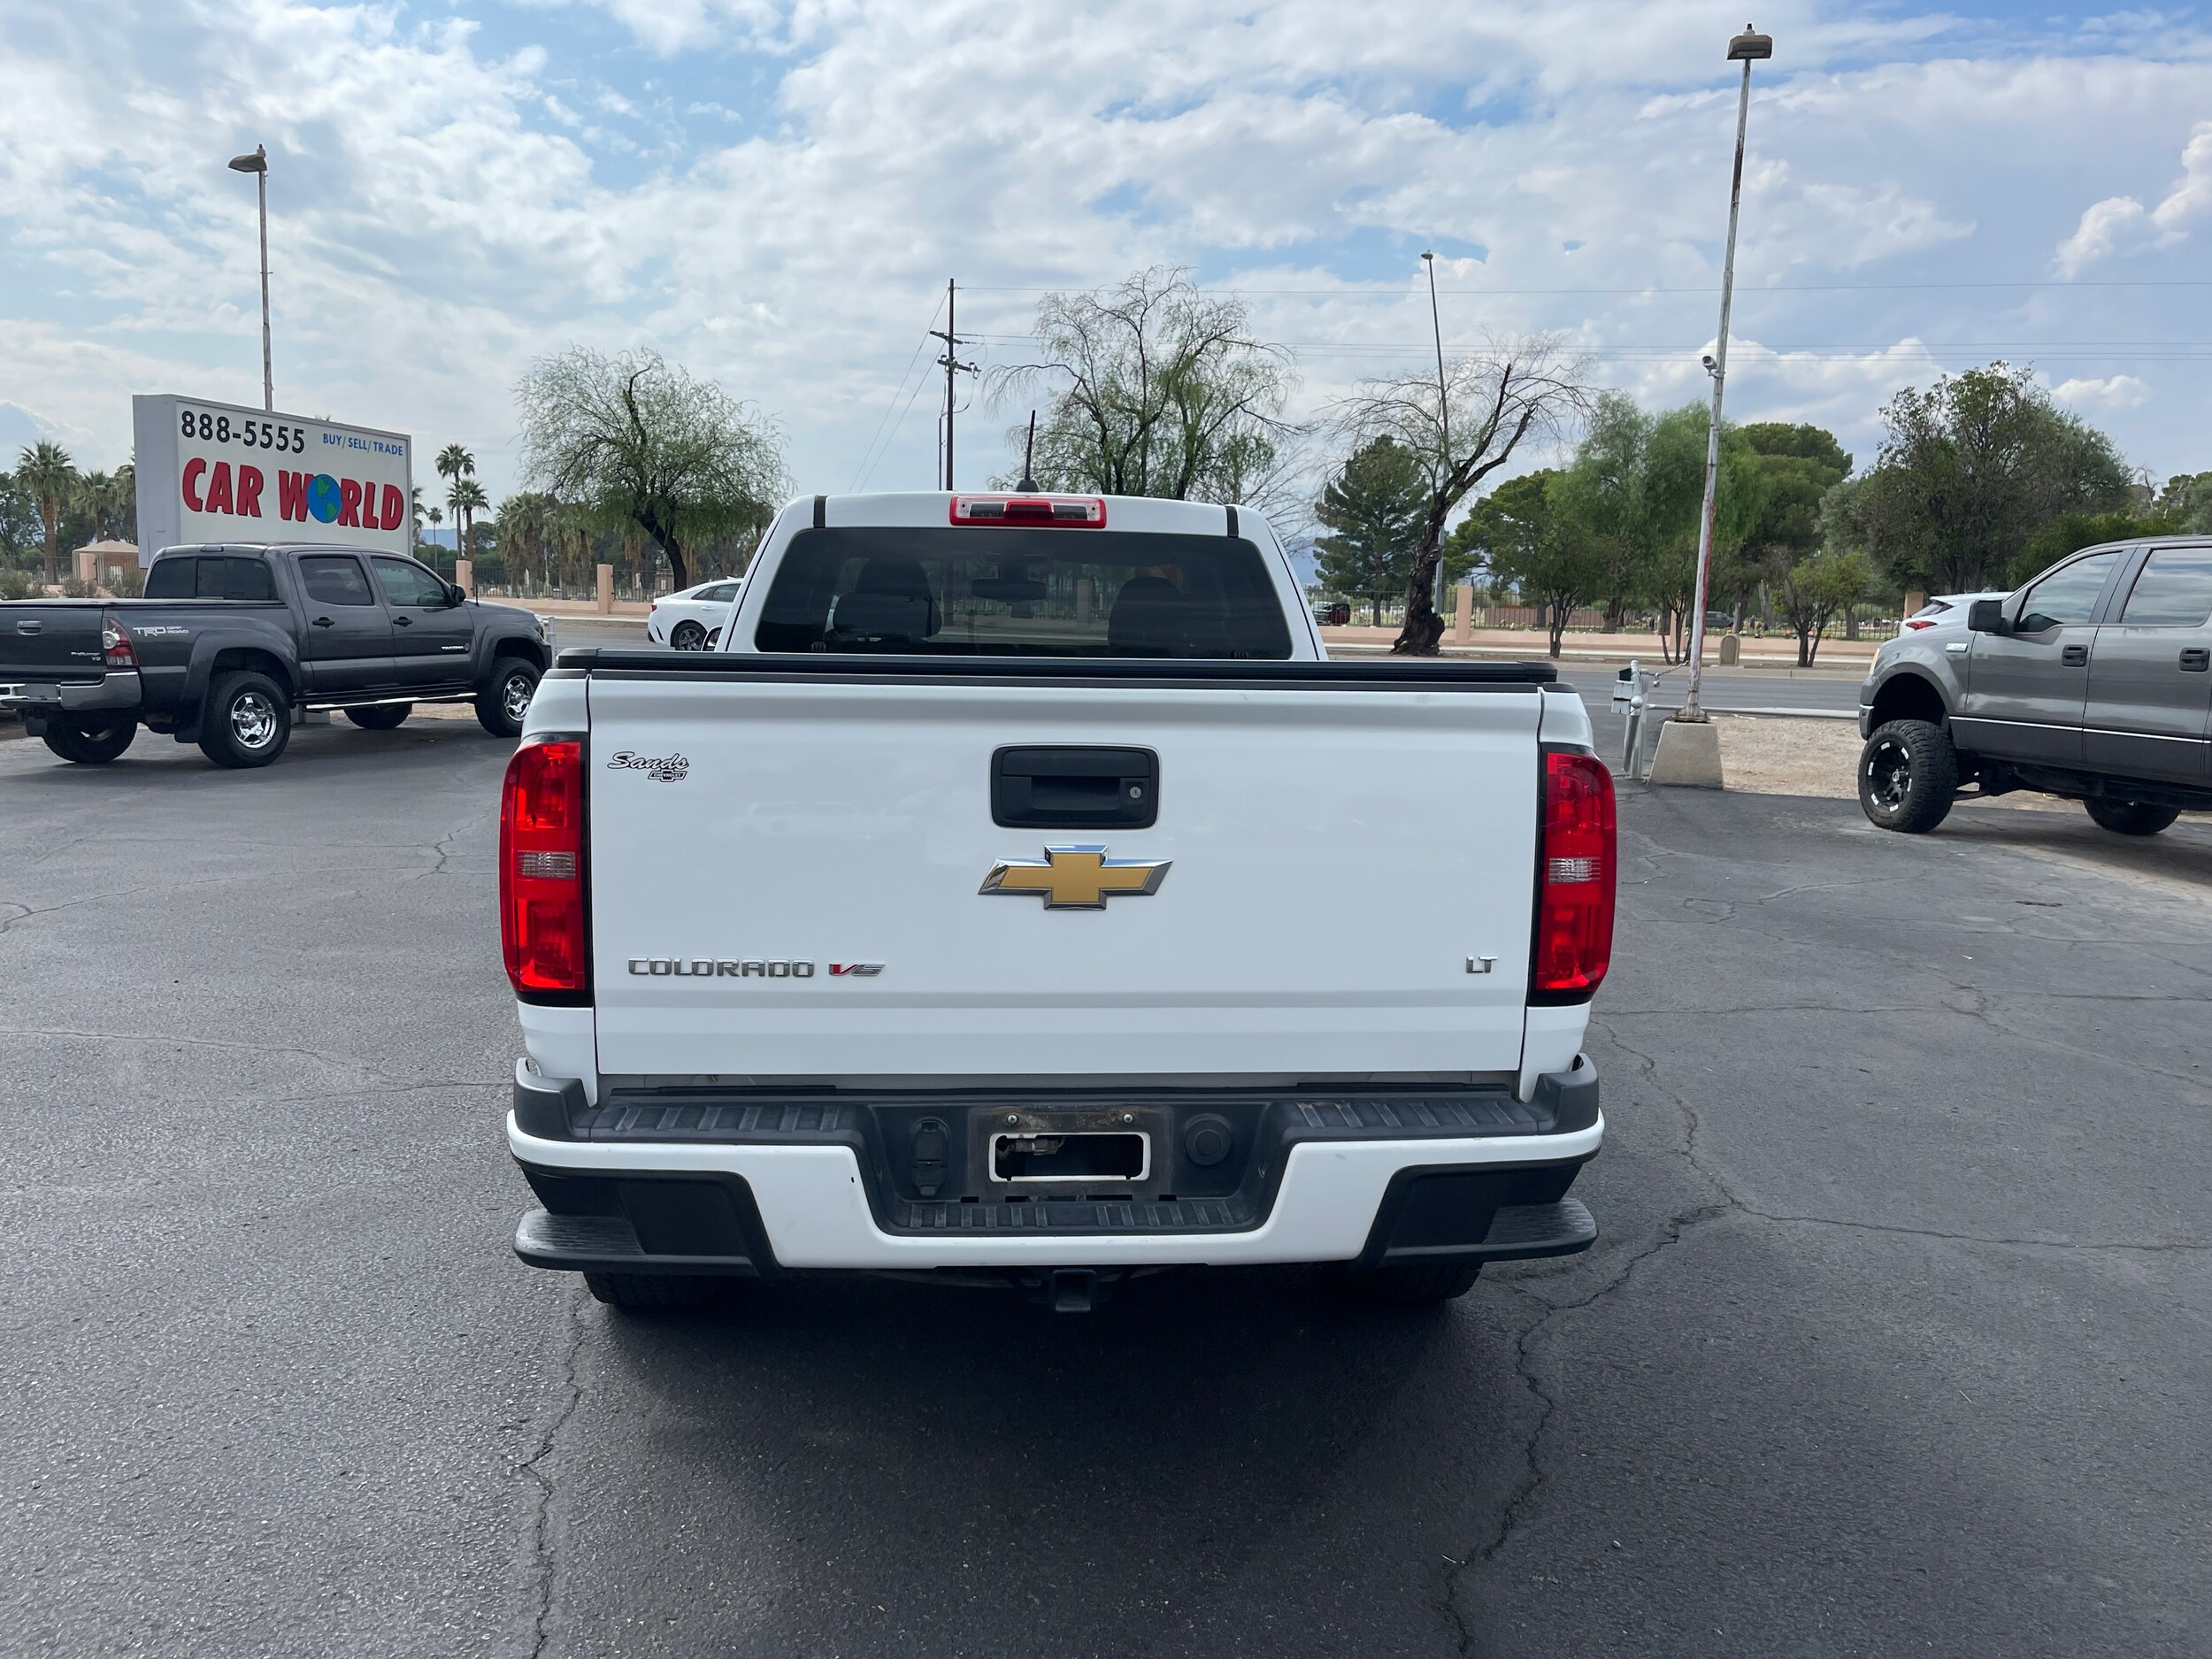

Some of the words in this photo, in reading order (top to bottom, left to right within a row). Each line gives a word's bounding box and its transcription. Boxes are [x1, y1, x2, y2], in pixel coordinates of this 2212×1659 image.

[181, 410, 305, 454] 888-5555
[182, 457, 264, 518] CAR
[279, 469, 404, 531] WORLD
[132, 626, 166, 637] TRD
[607, 750, 689, 771] Sands
[627, 956, 815, 978] COLORADO
[828, 961, 886, 977] V6
[1465, 956, 1499, 974] LT
